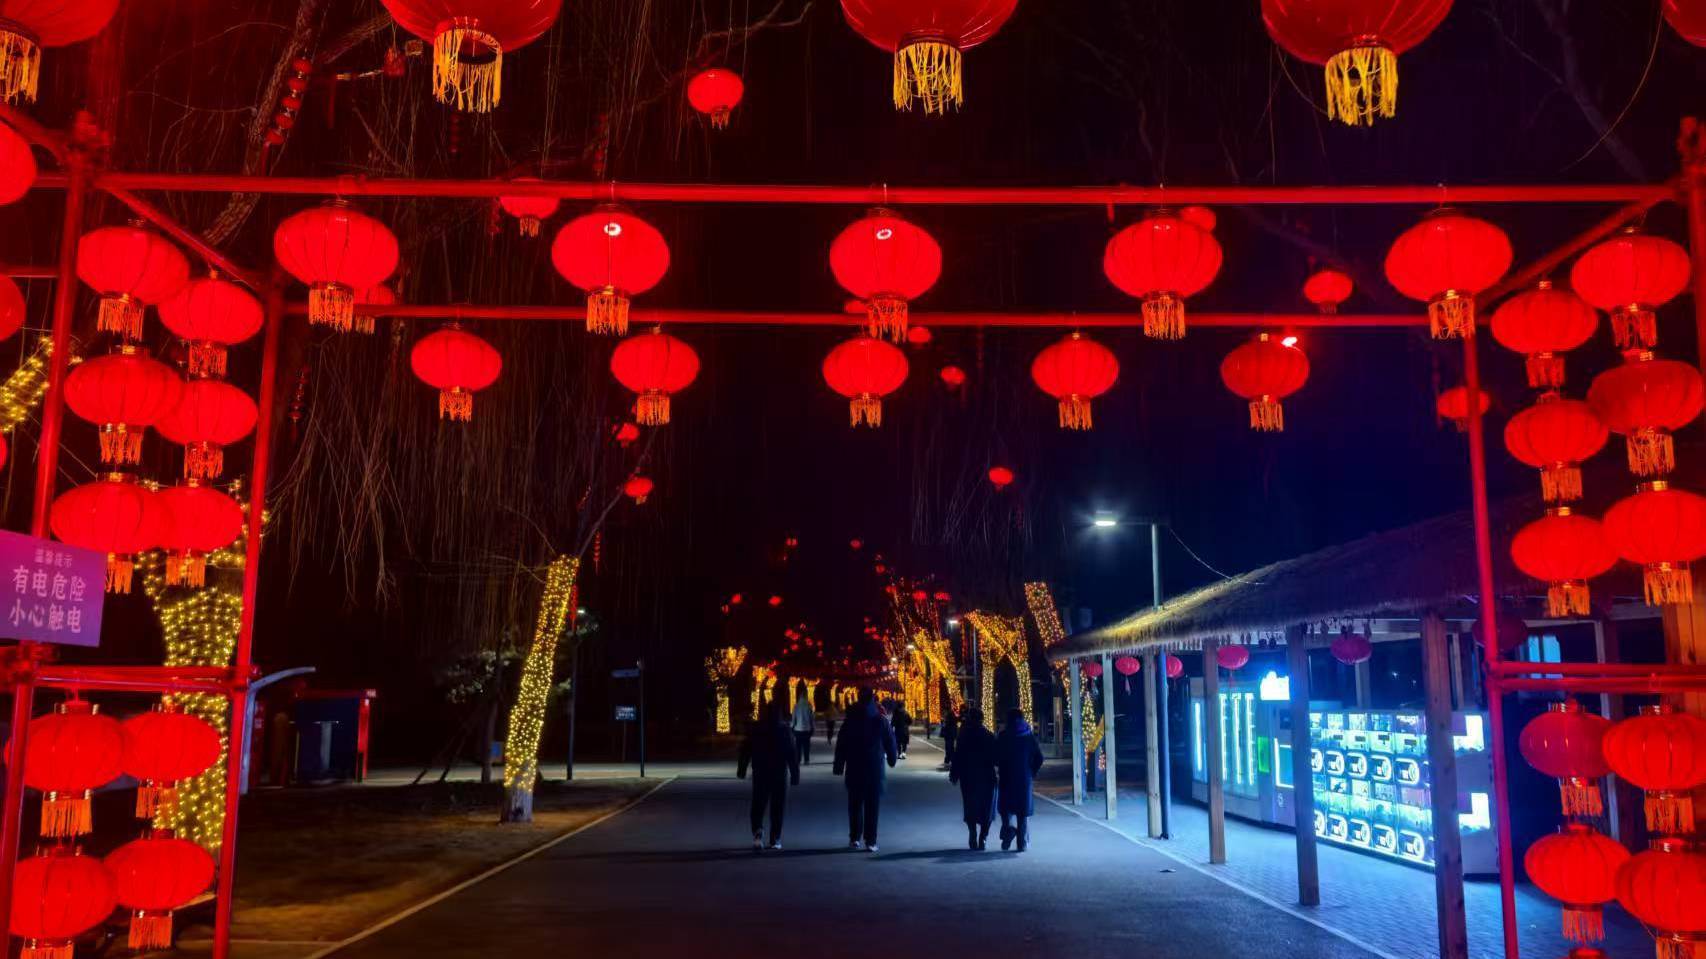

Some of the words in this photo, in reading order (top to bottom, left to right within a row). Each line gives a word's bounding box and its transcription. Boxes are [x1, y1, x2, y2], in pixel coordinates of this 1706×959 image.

[12, 564, 86, 601] 有电危险
[8, 598, 81, 633] 小心触电
